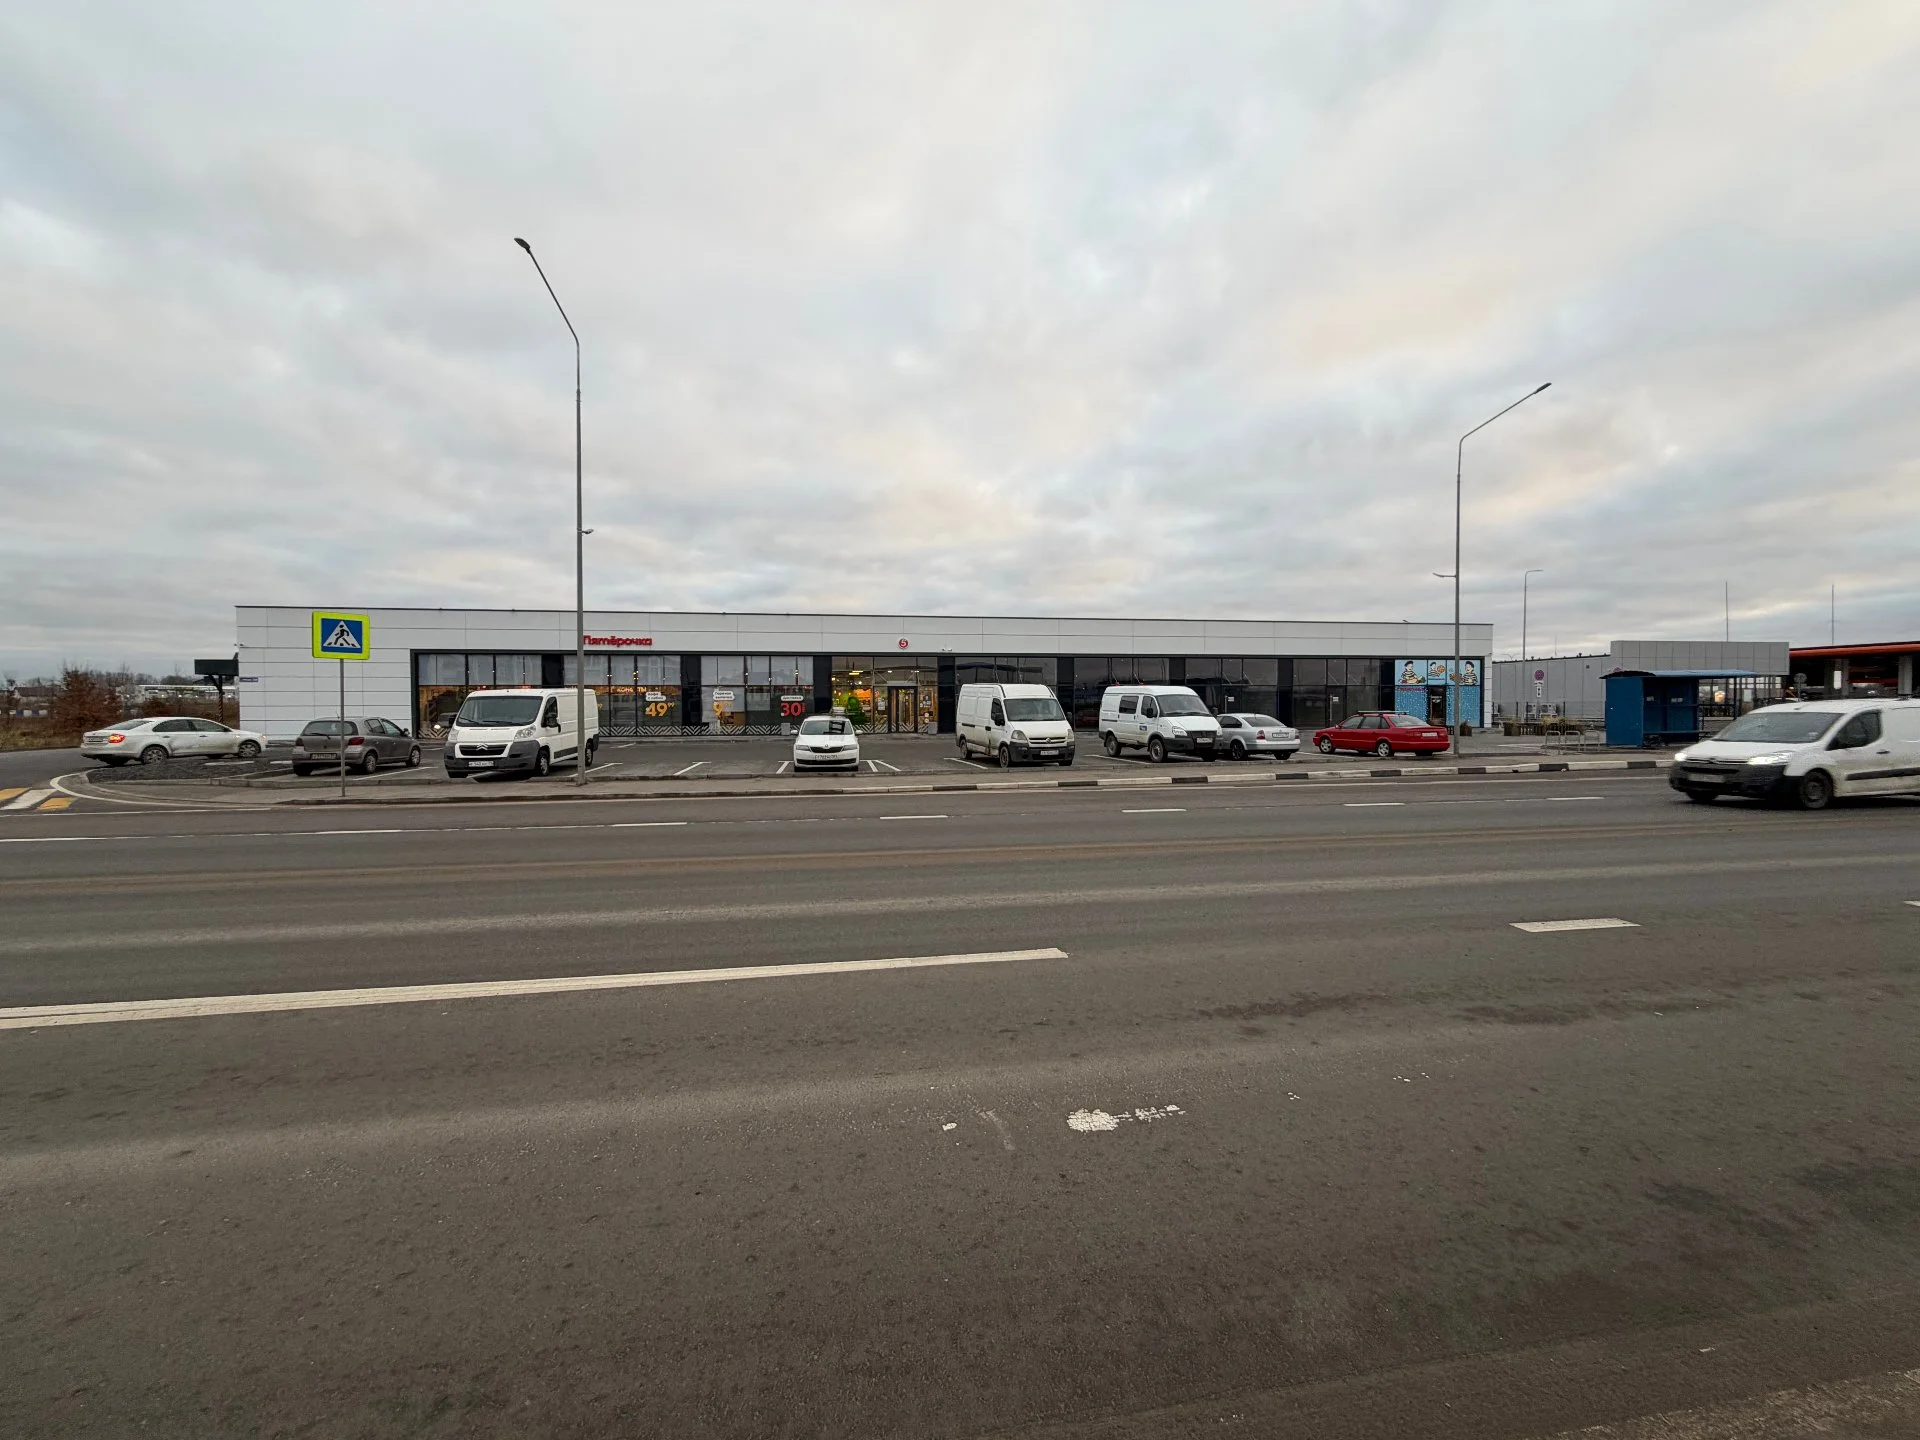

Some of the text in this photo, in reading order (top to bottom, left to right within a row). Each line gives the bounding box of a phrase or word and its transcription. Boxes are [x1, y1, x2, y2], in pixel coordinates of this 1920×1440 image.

[583, 635, 652, 647] Пятёрочка
[645, 702, 668, 717] 49
[781, 702, 802, 717] 30
